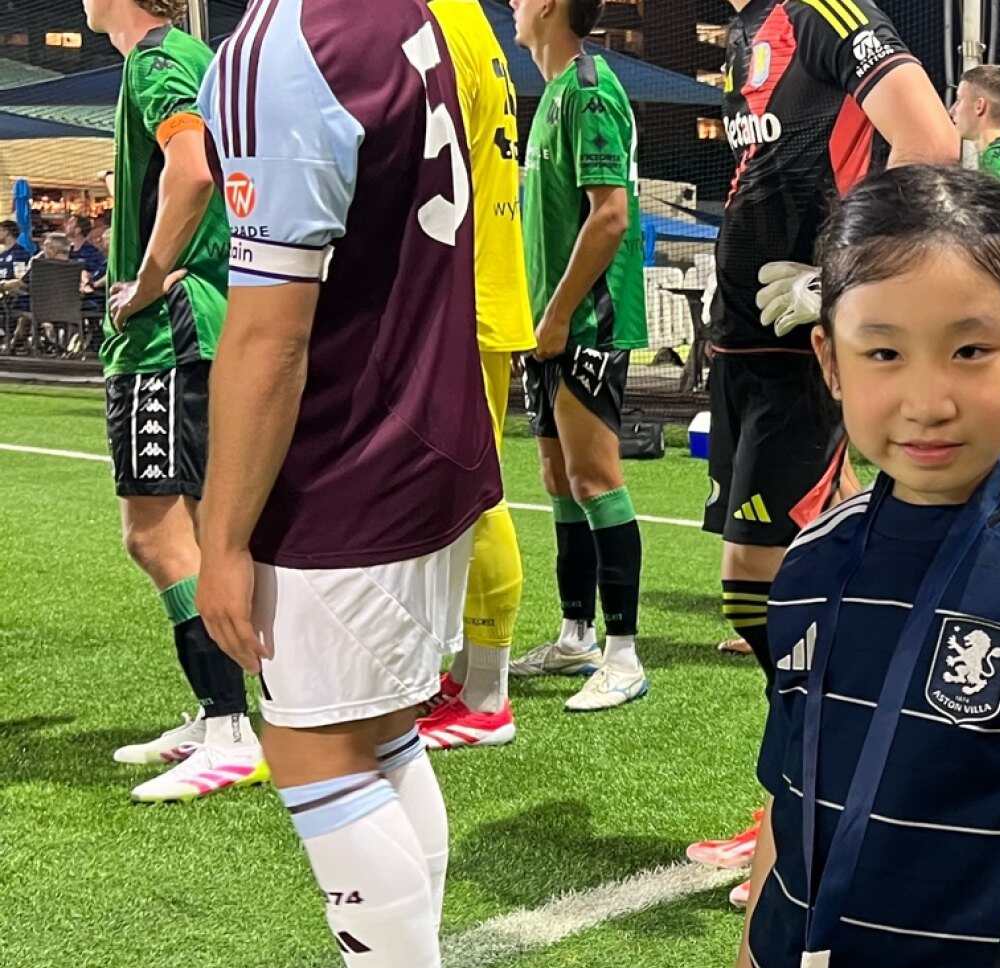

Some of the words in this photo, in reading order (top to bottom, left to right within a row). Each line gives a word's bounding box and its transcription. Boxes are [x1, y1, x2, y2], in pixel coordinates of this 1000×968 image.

[230, 225, 270, 238] RADE
[232, 242, 253, 263] ain
[932, 689, 962, 711] ASTON
[964, 703, 992, 714] VILLA
[327, 890, 364, 906] 74
